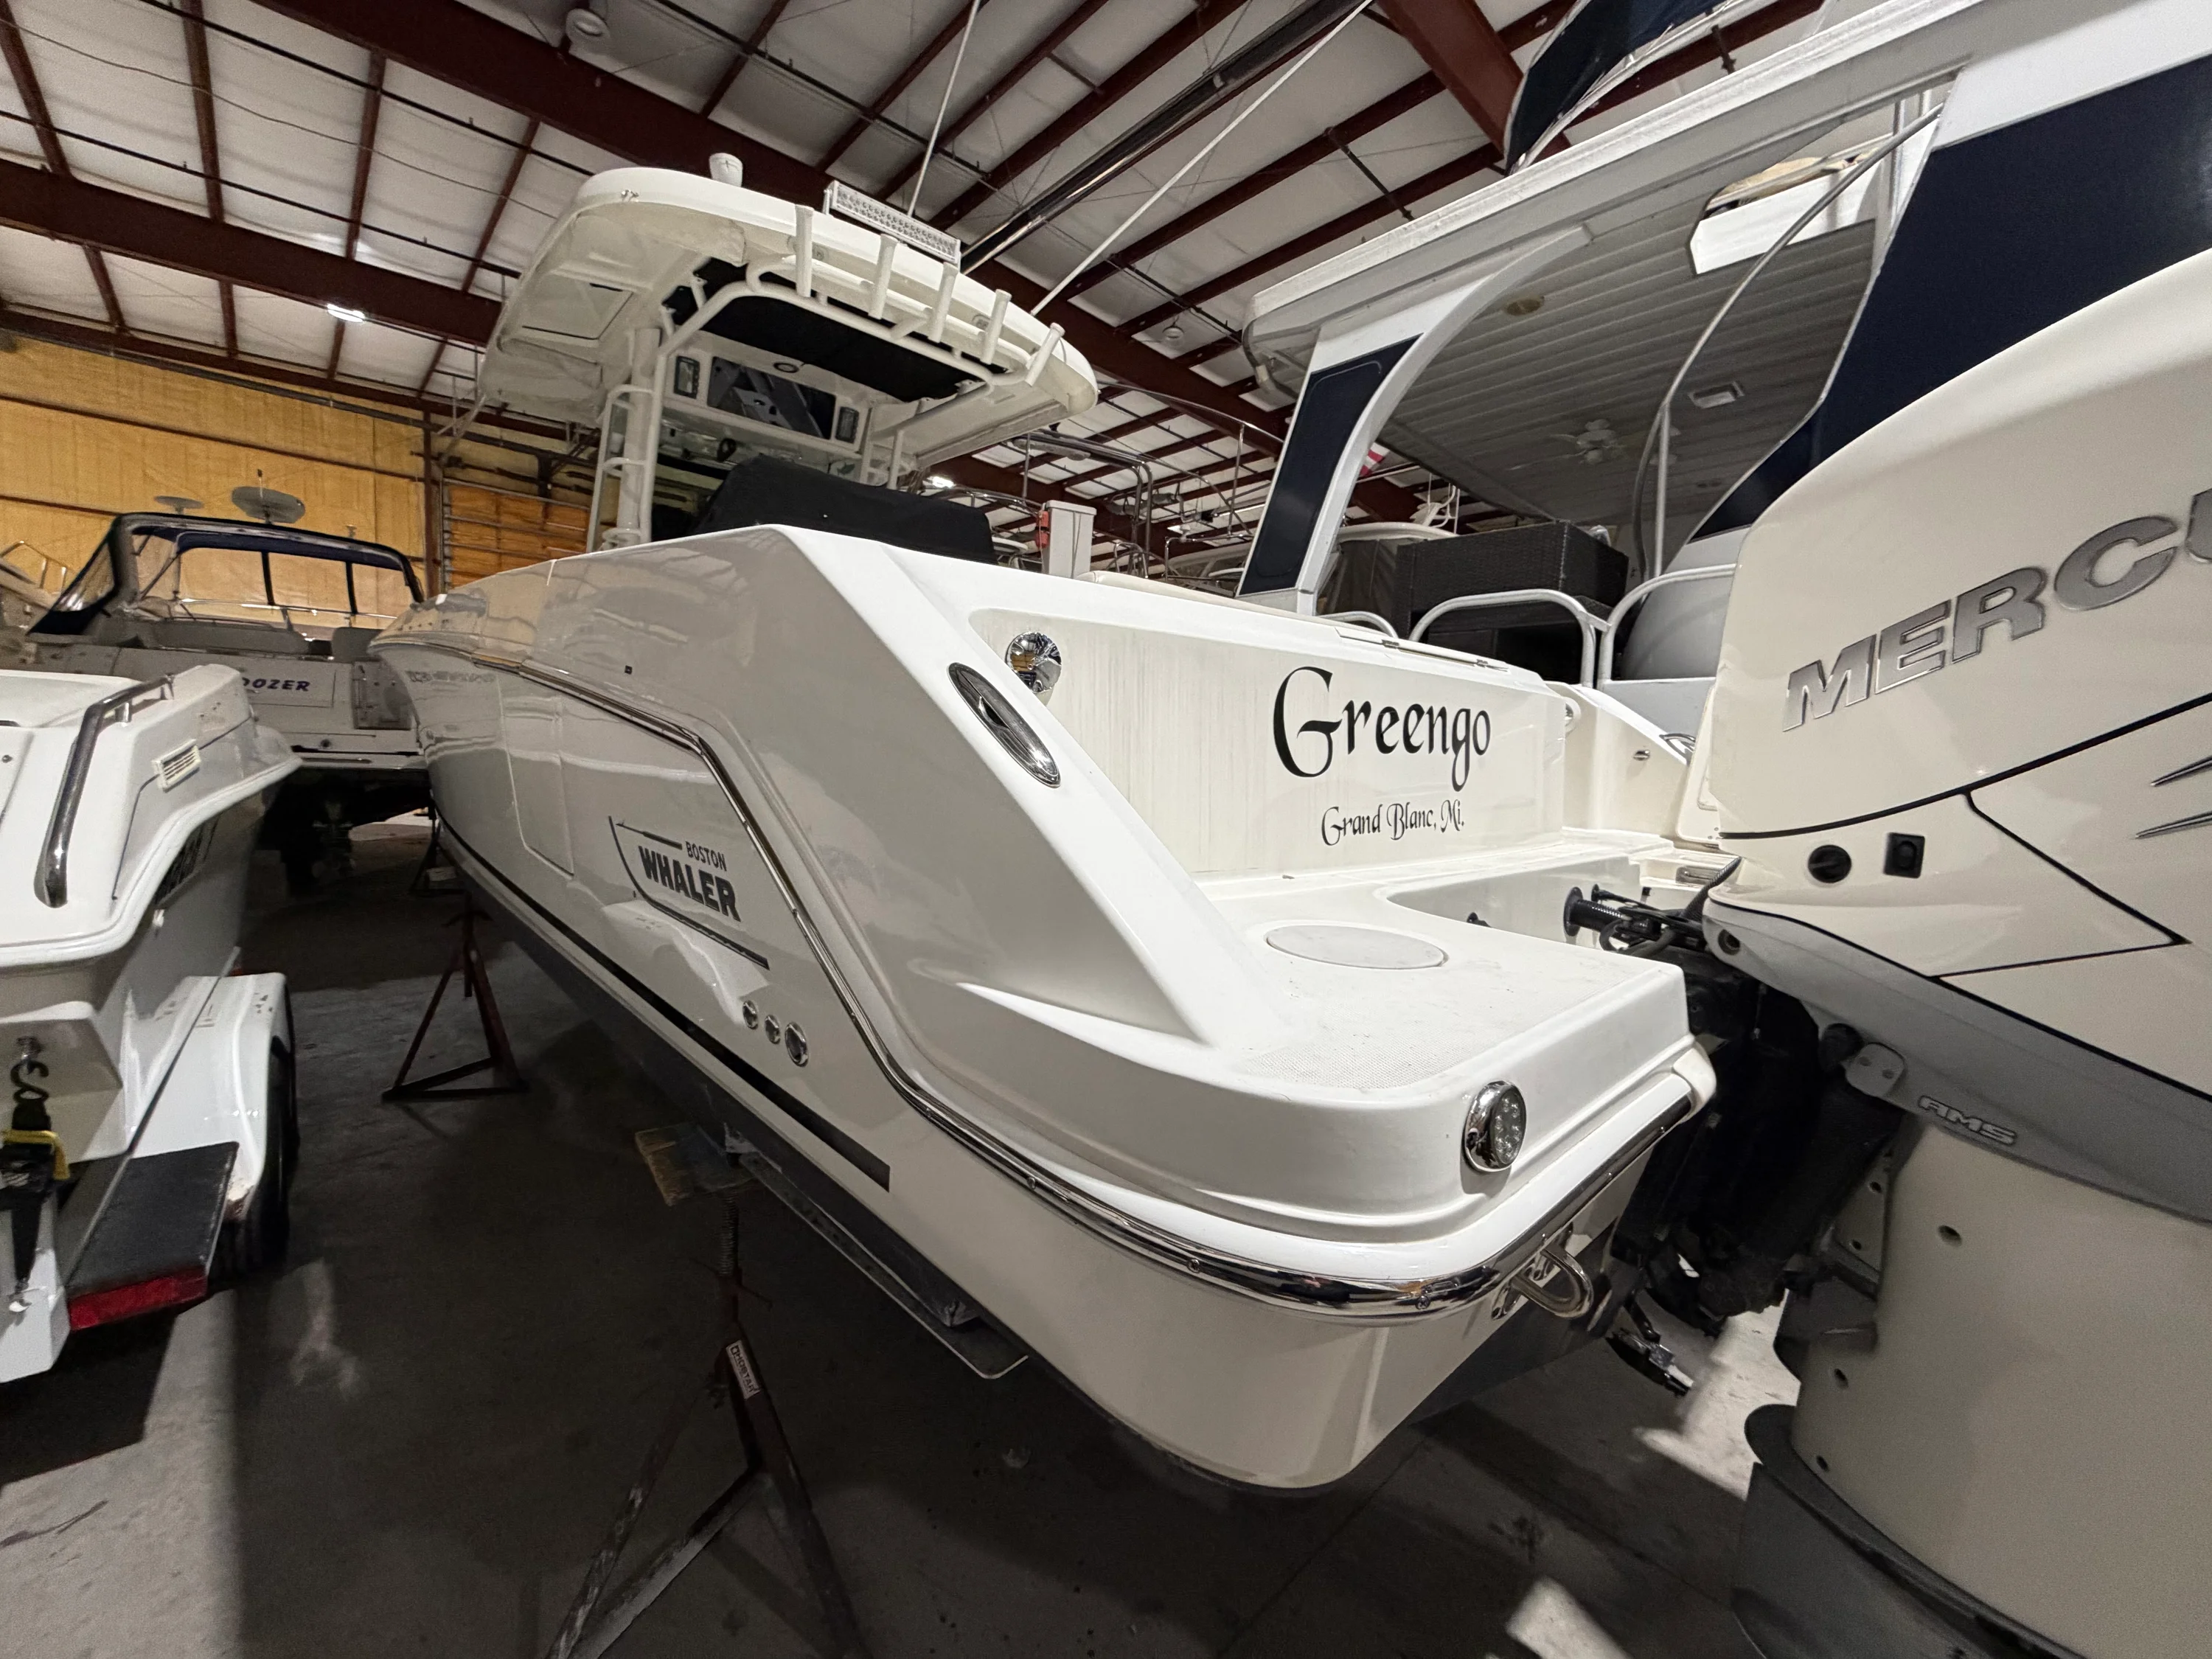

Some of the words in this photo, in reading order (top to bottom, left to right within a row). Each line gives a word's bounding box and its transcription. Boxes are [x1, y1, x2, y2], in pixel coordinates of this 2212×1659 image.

[1273, 666, 1491, 793] Greengo
[1321, 804, 1382, 846] Grand
[1386, 801, 1437, 841] Blanc,
[1441, 799, 1465, 833] Mi.
[685, 841, 728, 872] BOSTON
[638, 845, 742, 922] WHALER
[1917, 1094, 2018, 1146] AMS
